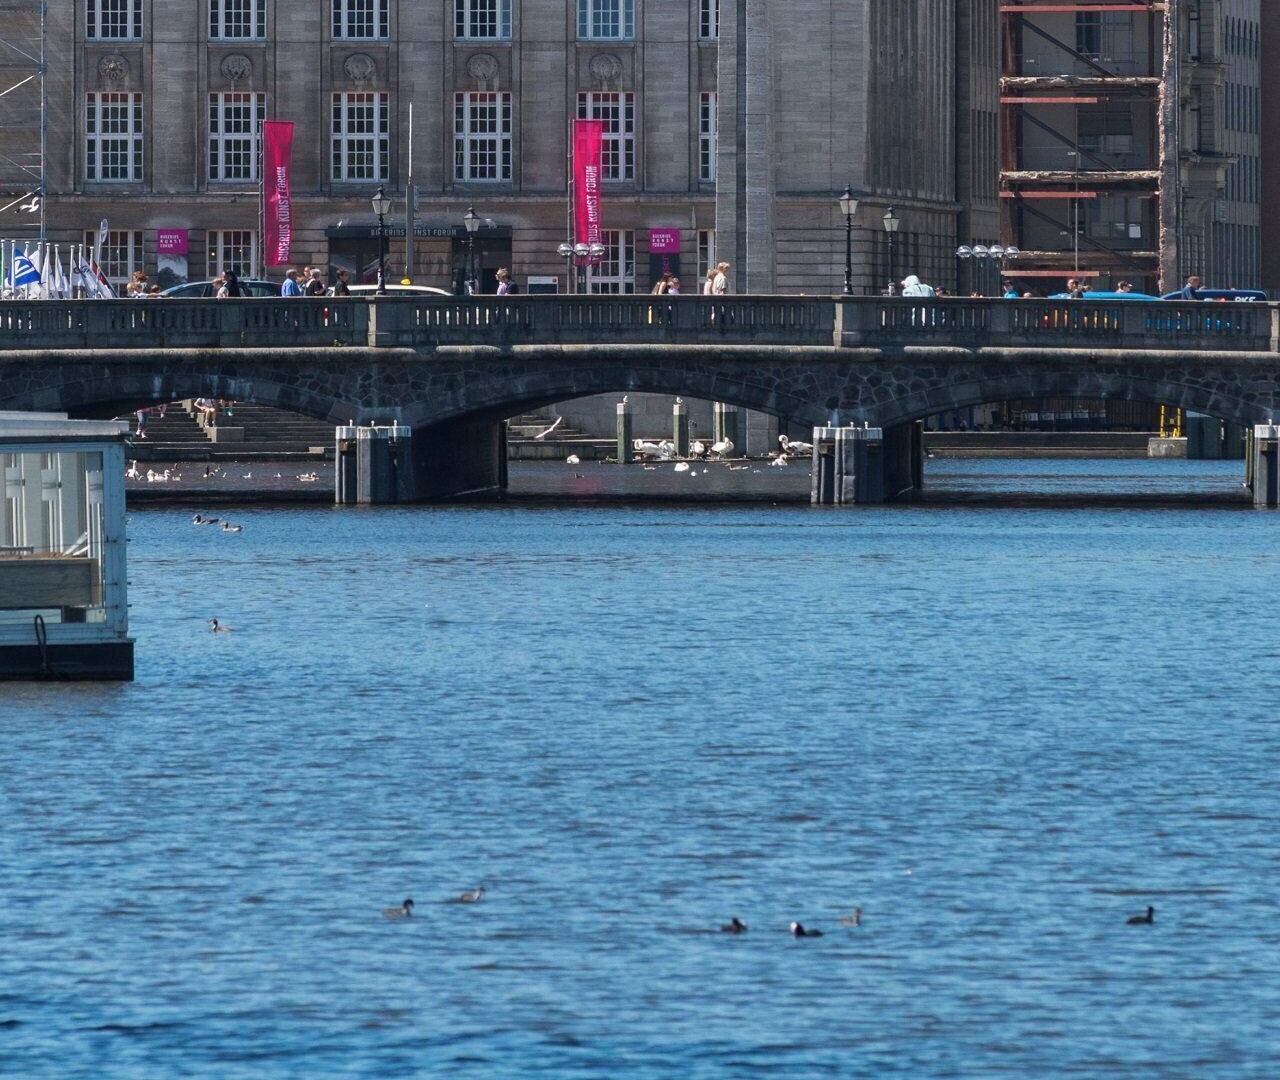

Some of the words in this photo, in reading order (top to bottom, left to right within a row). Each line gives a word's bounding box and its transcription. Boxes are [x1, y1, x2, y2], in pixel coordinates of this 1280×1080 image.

[276, 166, 287, 192] FORUM
[585, 165, 597, 192] FORUM
[278, 193, 290, 222] KUNST
[587, 195, 598, 222] KUNST
[277, 224, 291, 262] BUCERIUS
